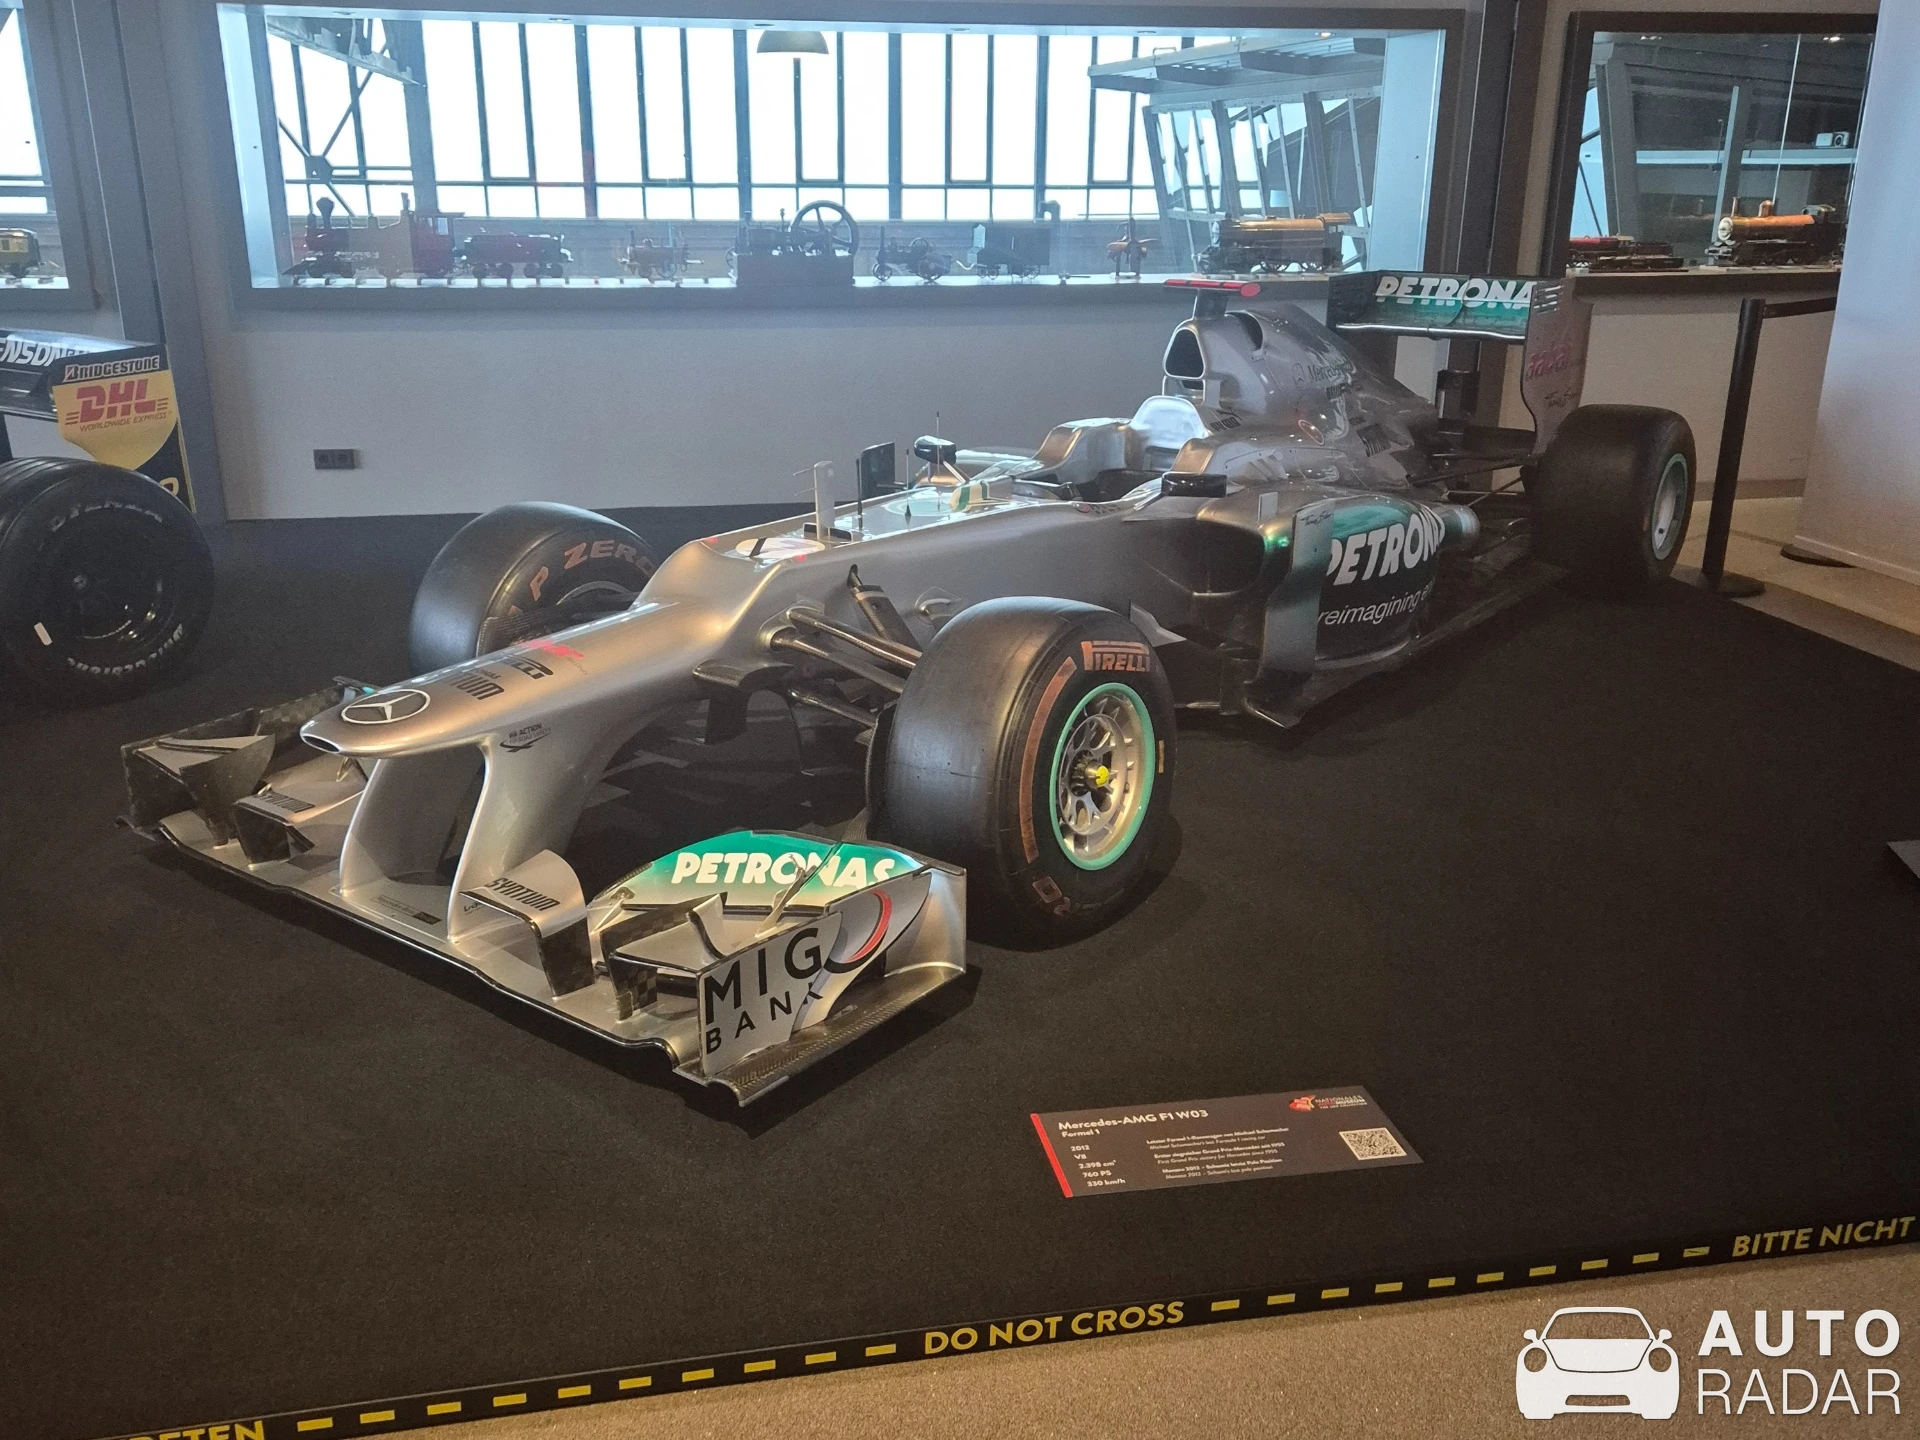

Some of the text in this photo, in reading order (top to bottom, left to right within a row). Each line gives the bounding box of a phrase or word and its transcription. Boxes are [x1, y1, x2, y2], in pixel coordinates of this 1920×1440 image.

[63, 355, 160, 383] BRIDGESTONE
[77, 379, 156, 423] DHL
[80, 412, 167, 432] WORLDWIDE EXPRESS
[563, 539, 658, 579] ZERO
[1326, 503, 1446, 586] PETRONA
[1318, 590, 1421, 625] reimagining
[1081, 640, 1150, 672] PIRELLI
[671, 852, 895, 888] PETRONAS
[484, 877, 561, 912] SYNTIUM
[704, 928, 823, 1025] MIG
[706, 982, 824, 1055] BANK
[1058, 1109, 1209, 1131] Mercedes-AMG F1 W03
[1061, 1129, 1094, 1138] Formel
[1070, 1144, 1091, 1152] 2012
[1104, 1178, 1126, 1186] km/h
[1731, 1215, 1916, 1257] BITTE NICHT
[924, 1301, 1185, 1355] DO NOT CROSS
